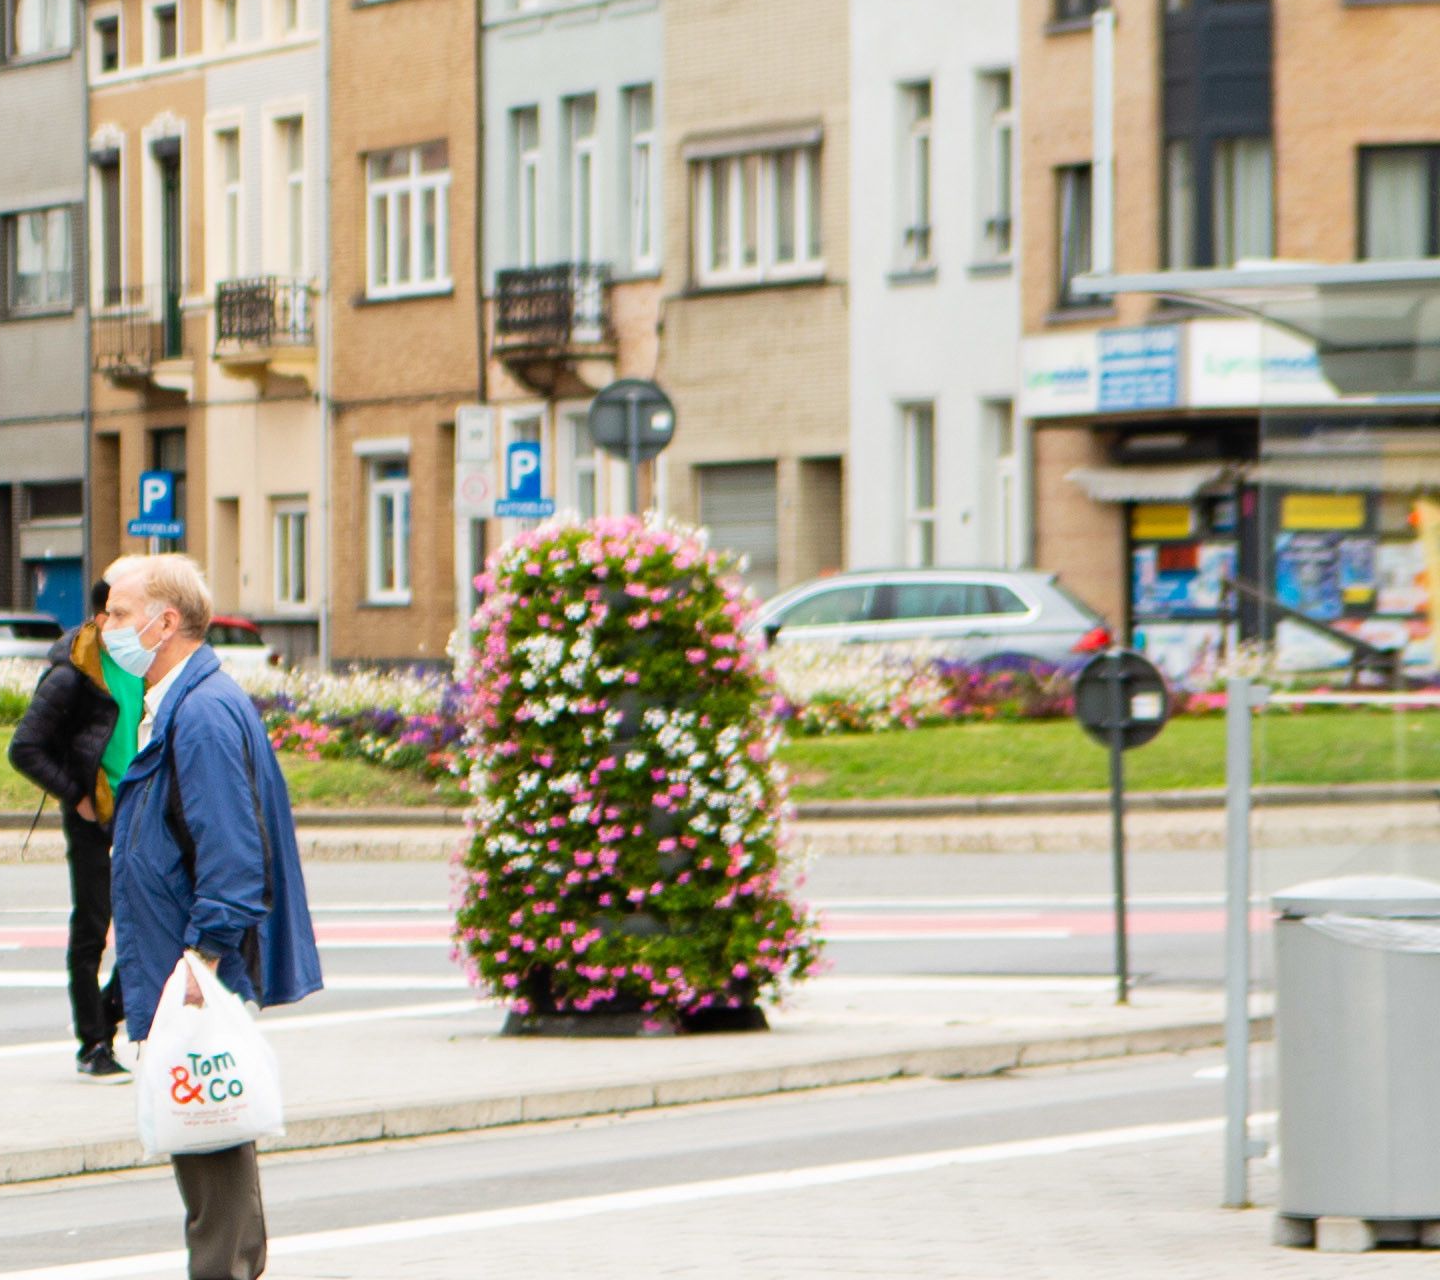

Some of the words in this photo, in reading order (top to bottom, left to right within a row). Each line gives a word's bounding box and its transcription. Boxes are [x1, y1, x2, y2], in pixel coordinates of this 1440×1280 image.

[511, 450, 538, 490] P
[143, 479, 167, 513] P
[187, 1052, 236, 1076] Tom
[209, 1078, 243, 1102] Co
